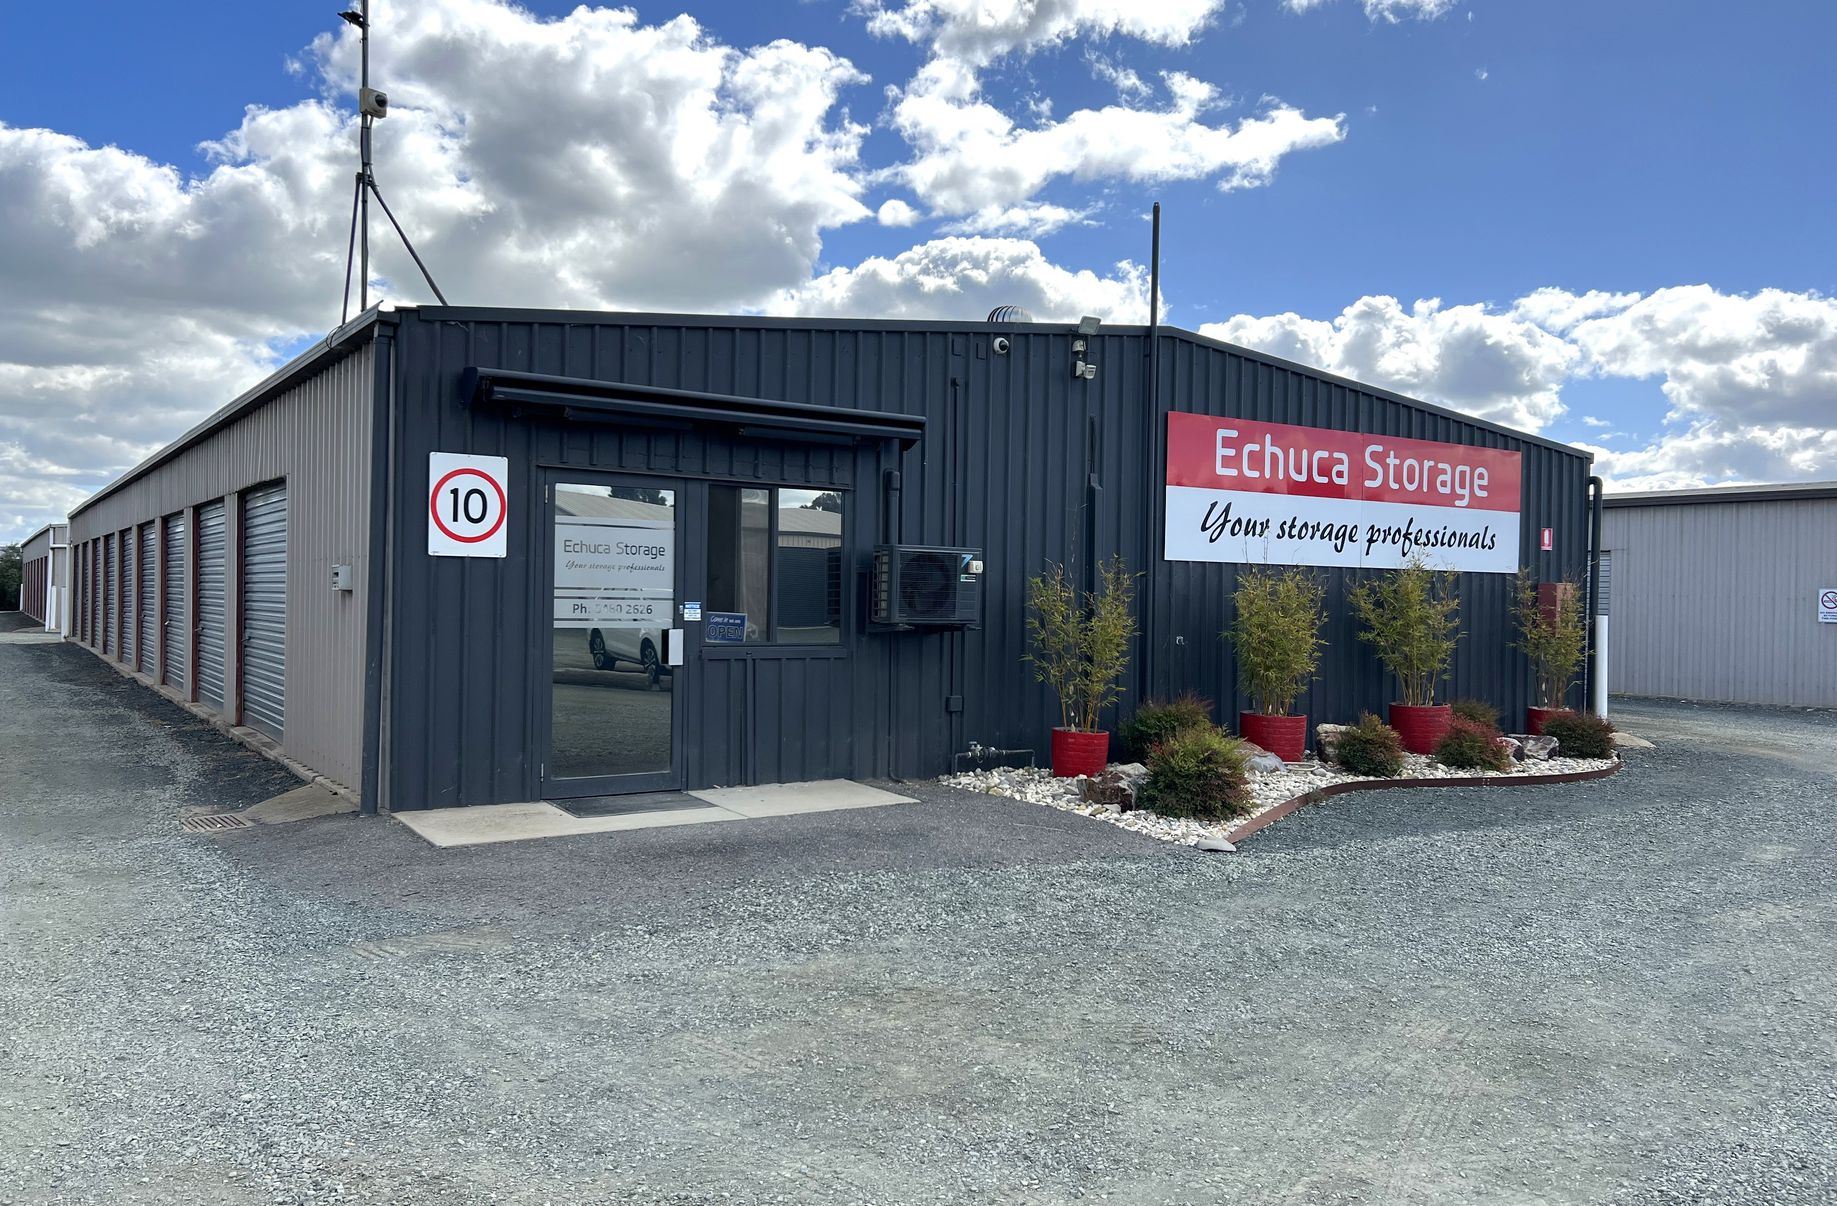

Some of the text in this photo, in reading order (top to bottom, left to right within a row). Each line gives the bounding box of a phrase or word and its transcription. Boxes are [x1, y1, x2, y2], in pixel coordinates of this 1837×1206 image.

[1215, 428, 1489, 507] Echuca Storage
[450, 487, 488, 524] 10
[1200, 500, 1496, 558] Your storage professionals
[563, 539, 666, 560] Echuca Storage
[565, 560, 587, 570] Your
[572, 603, 591, 614] Ph.
[625, 604, 653, 615] 2626
[707, 624, 743, 640] OPEN
